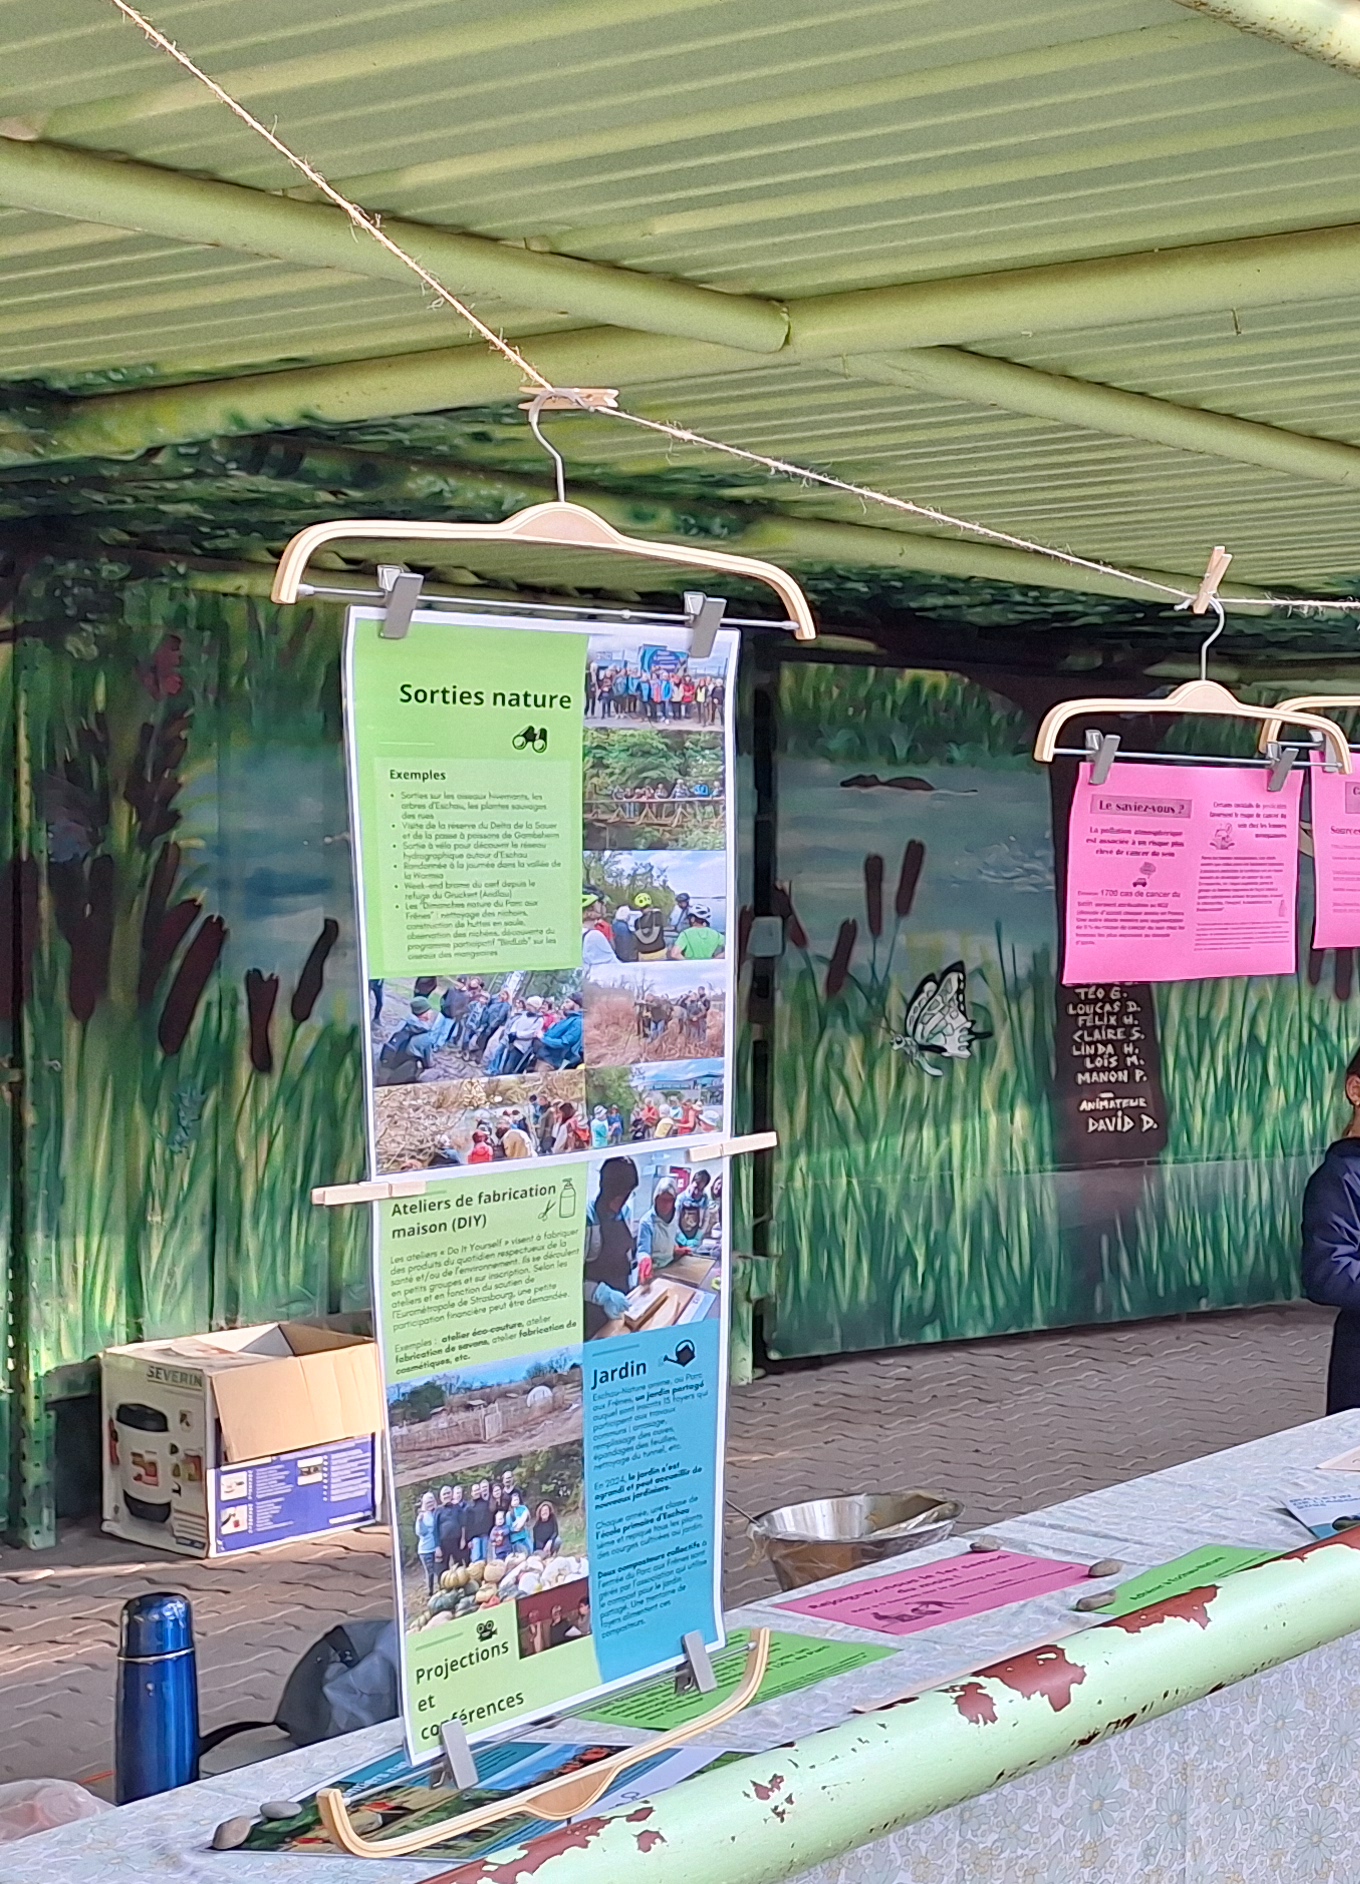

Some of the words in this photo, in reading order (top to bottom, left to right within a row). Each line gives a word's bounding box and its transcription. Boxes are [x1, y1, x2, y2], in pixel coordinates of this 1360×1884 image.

[399, 683, 485, 707] Sorties
[492, 686, 572, 711] nature
[389, 768, 447, 783] Exemples
[1099, 800, 1112, 810] Le
[1116, 802, 1176, 814] saviez-vous
[1178, 804, 1184, 814] ?
[1074, 986, 1105, 1000] TÉO
[1068, 1000, 1121, 1014] LOUCAS
[1126, 1000, 1142, 1012] D.
[1123, 1014, 1138, 1025] H.
[1073, 1026, 1126, 1042] CLAIRE
[1130, 1027, 1145, 1040] S.
[1072, 1042, 1114, 1056] LINDA
[1124, 1042, 1139, 1054] H.
[1126, 1055, 1145, 1066] M.
[1077, 1070, 1128, 1084] MANON
[1134, 1068, 1148, 1082] P.
[1087, 1111, 1135, 1133] DAVID
[1140, 1114, 1158, 1132] D.
[392, 1199, 451, 1217] Ateliers
[455, 1194, 474, 1208] de
[478, 1184, 556, 1205] fabrication
[392, 1220, 448, 1239] maison
[451, 1214, 487, 1233] (DIY)
[390, 1256, 404, 1264] Les
[406, 1251, 438, 1262] ateliers
[447, 1246, 460, 1256] Do
[470, 1238, 503, 1252] Yourself
[512, 1235, 534, 1244] visent
[544, 1228, 579, 1242] fabriquer
[390, 1266, 406, 1276] des
[408, 1260, 442, 1276] produits
[443, 1258, 455, 1267] du
[456, 1252, 496, 1266] quotidien
[497, 1244, 545, 1259] respectueux
[546, 1240, 558, 1250] de
[560, 1239, 567, 1248] la
[390, 1276, 414, 1286] santé
[416, 1272, 440, 1282] et/ou
[442, 1268, 453, 1278] de
[522, 1256, 530, 1264] Ils
[543, 1248, 580, 1262] déroulent
[391, 1290, 402, 1298] en
[404, 1284, 428, 1300] petits
[429, 1278, 462, 1294] groupes
[464, 1277, 474, 1285] et
[474, 1275, 487, 1283] sur
[533, 1262, 555, 1274] Selon
[556, 1260, 568, 1269] les
[394, 1340, 432, 1352] Exemples
[442, 1331, 470, 1344] atelier
[472, 1320, 524, 1336] éco-couture,
[526, 1314, 551, 1326] atelier
[395, 1349, 444, 1364] fabrication
[445, 1344, 456, 1354] de
[458, 1338, 490, 1350] savons,
[492, 1332, 518, 1344] atelier
[518, 1322, 564, 1338] fabrication
[566, 1320, 577, 1328] de
[396, 1359, 452, 1375] cosmétiques,
[454, 1354, 470, 1362] etc.
[146, 1366, 202, 1387] SEVERIN
[590, 1360, 647, 1391] Jardin
[416, 1640, 509, 1685] Projections
[418, 1694, 436, 1712] et
